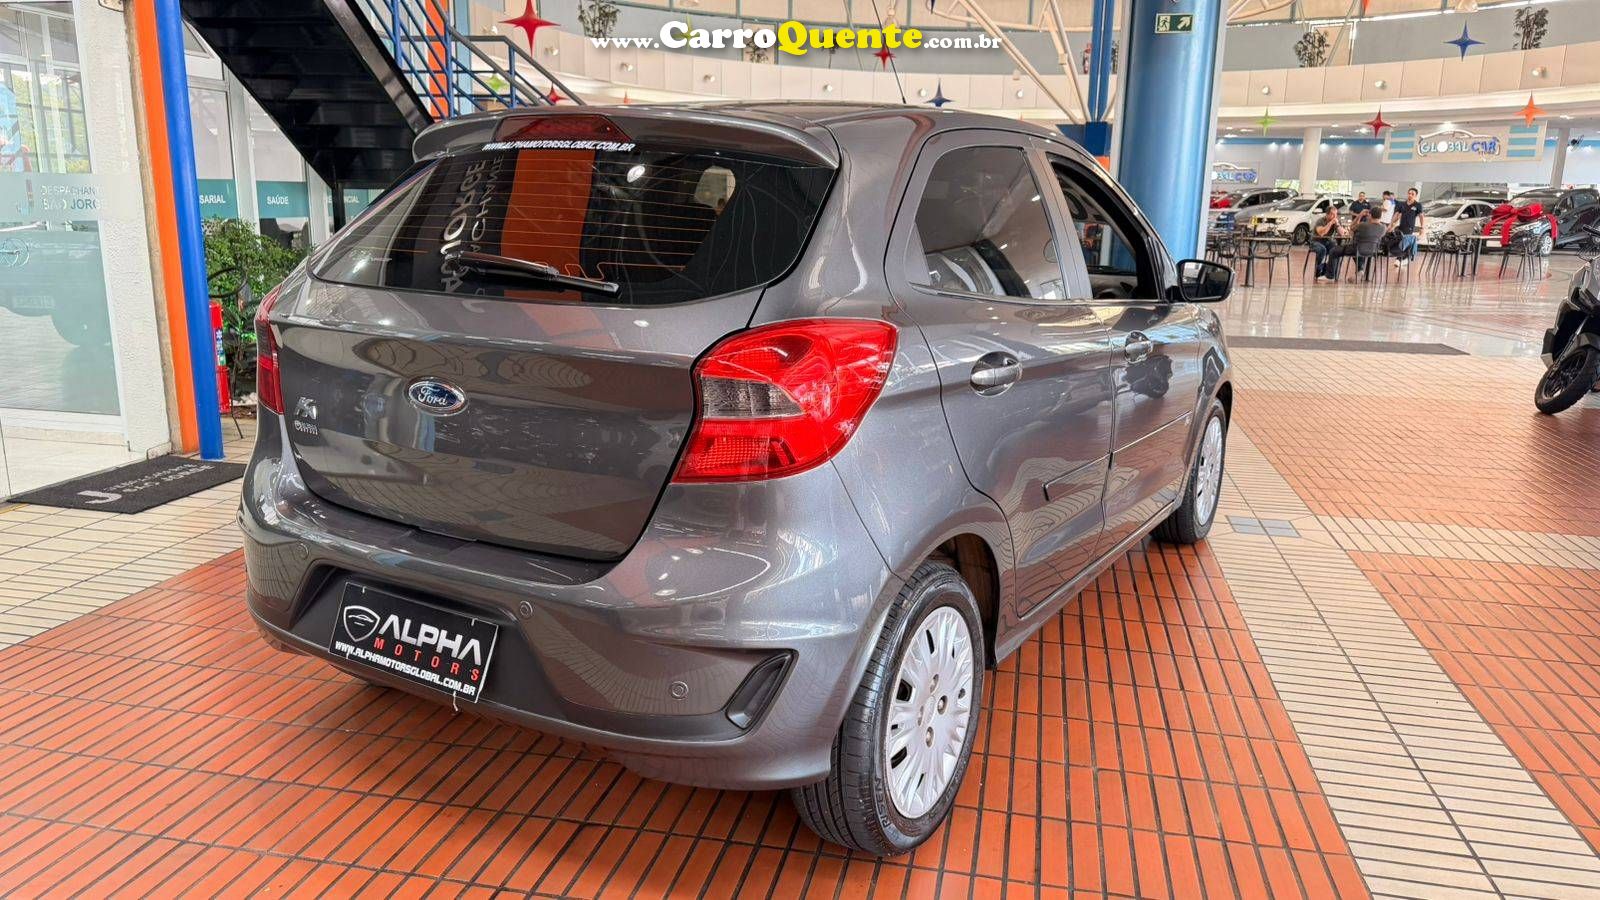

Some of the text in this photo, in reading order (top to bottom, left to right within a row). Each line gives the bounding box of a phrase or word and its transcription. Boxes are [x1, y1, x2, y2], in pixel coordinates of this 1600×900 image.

[417, 386, 448, 405] Ford
[373, 636, 480, 682] MOTORS
[378, 614, 482, 666] ALPHA
[335, 640, 476, 696] WWW.ALPHAMOTORSGLOBAL.COM.BR
